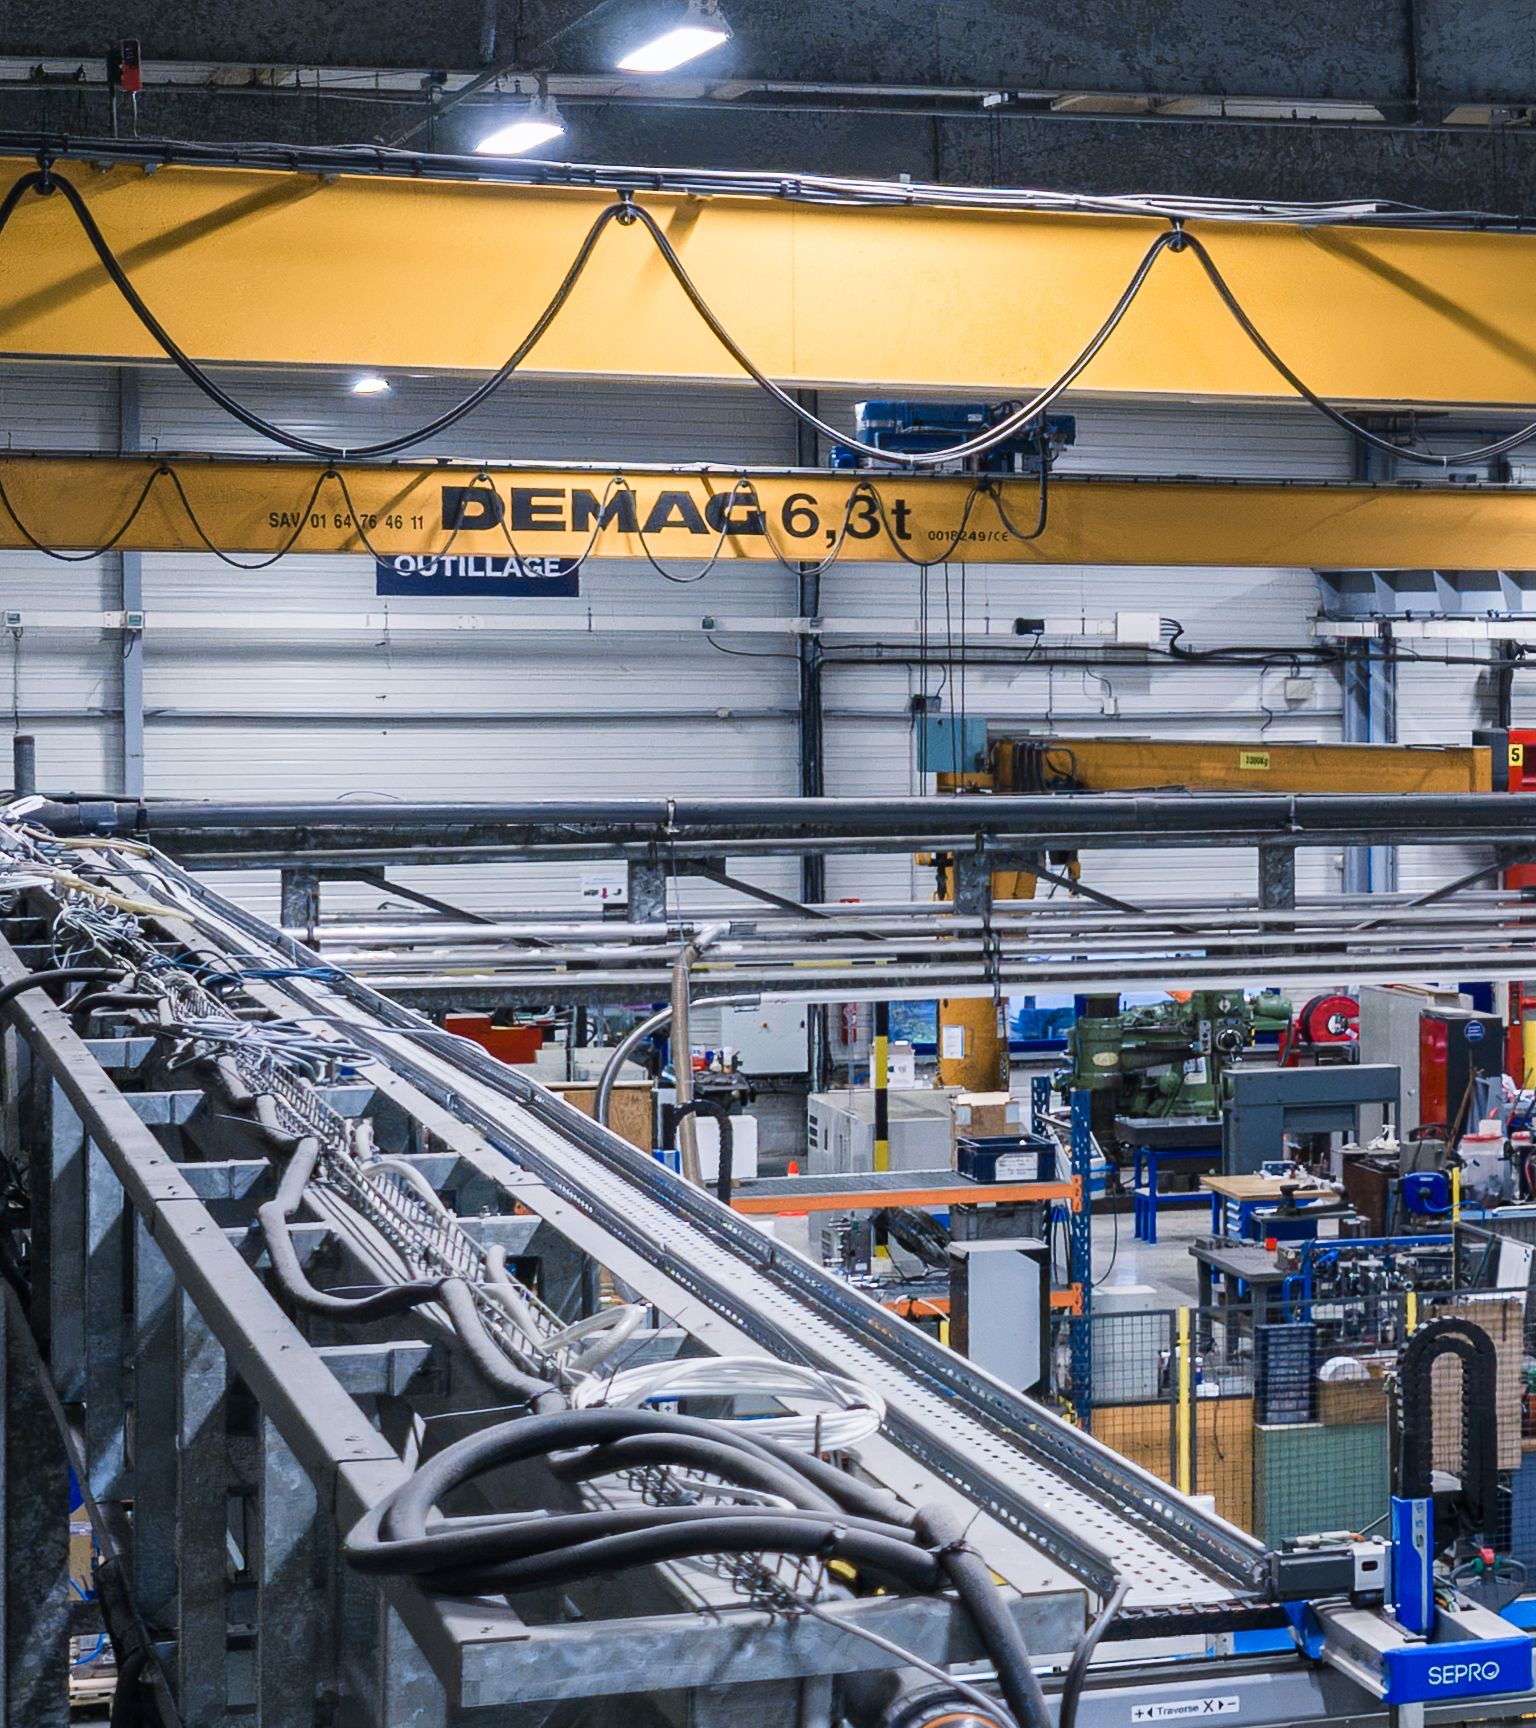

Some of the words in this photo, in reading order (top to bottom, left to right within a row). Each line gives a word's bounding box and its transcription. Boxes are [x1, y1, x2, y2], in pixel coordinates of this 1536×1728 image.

[442, 485, 766, 535] DEMAG
[268, 512, 300, 530] SAV
[311, 513, 327, 529] 01
[334, 514, 352, 529] 64
[360, 515, 377, 529] 76
[386, 515, 403, 530] 46
[411, 515, 425, 530] 11
[394, 556, 562, 578] OUTILLAGE
[1511, 747, 1520, 762] 5
[1428, 1661, 1500, 1685] SEPRO
[1157, 1704, 1199, 1716] Traverse
[1203, 1700, 1214, 1713] X
